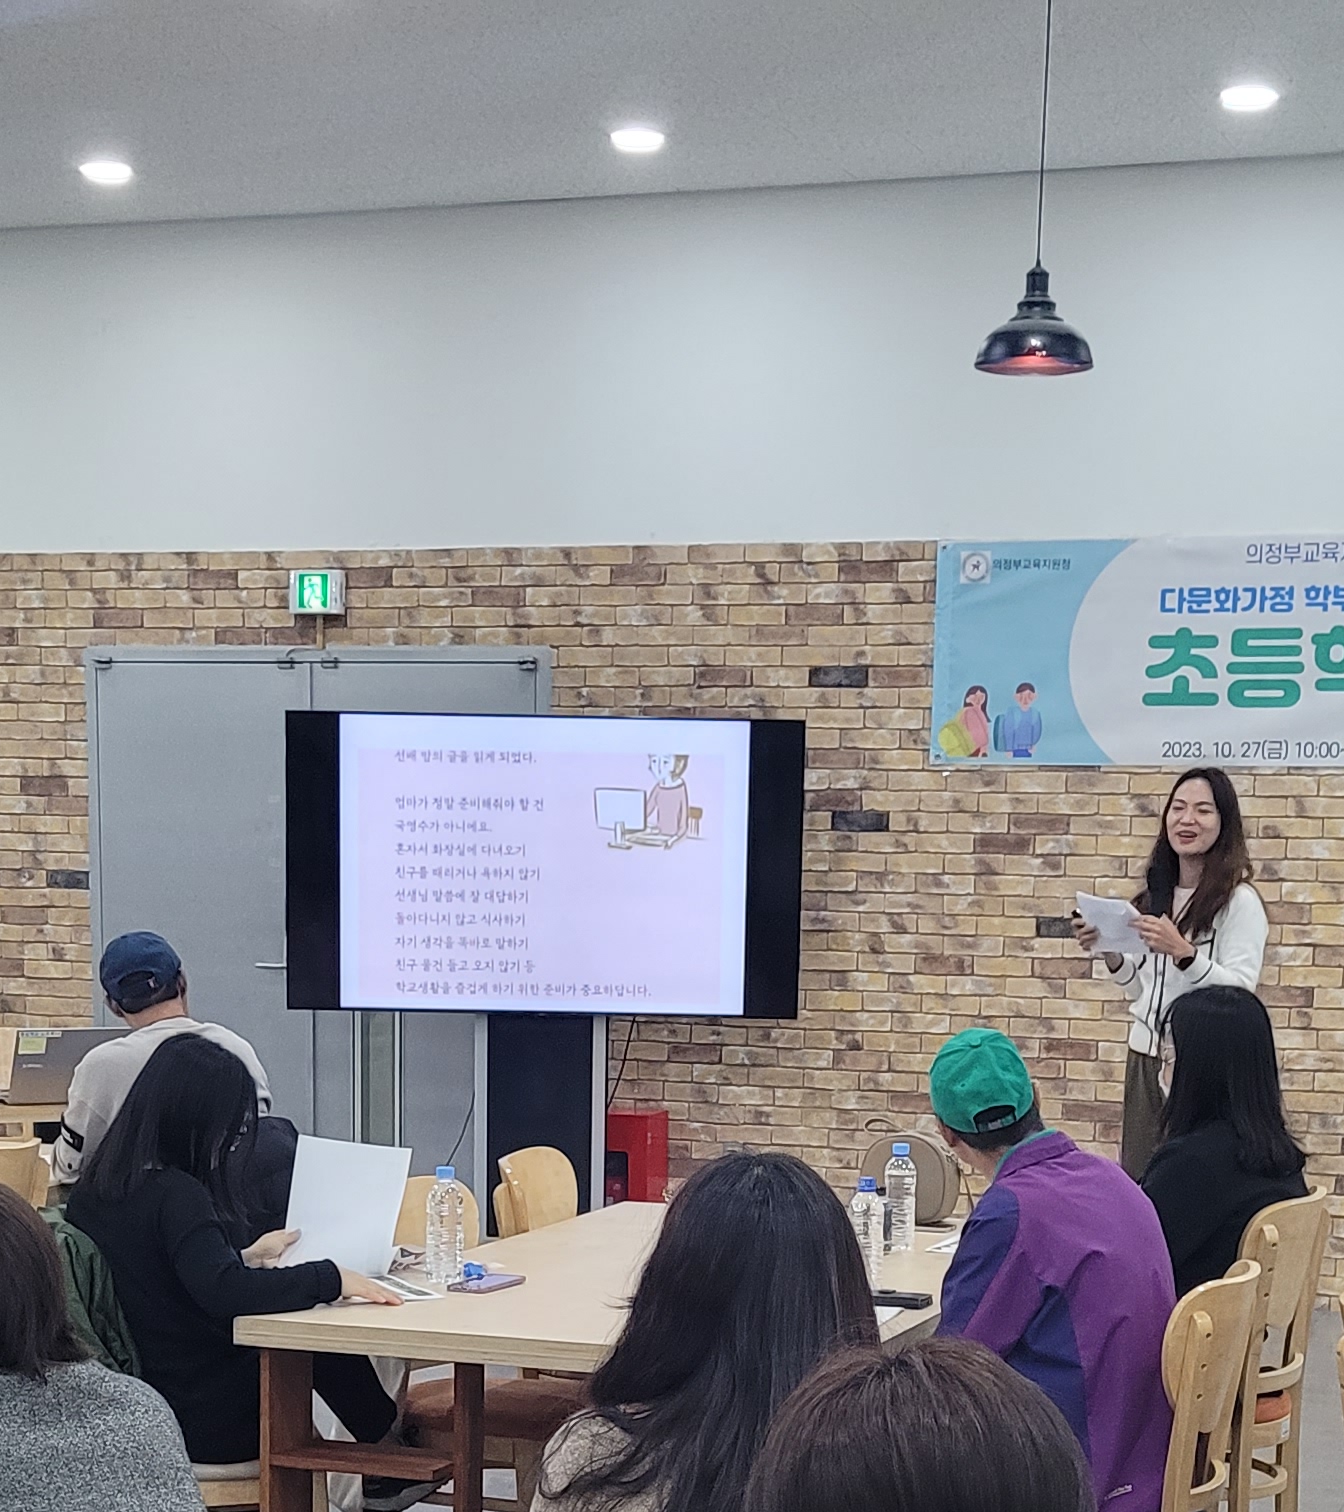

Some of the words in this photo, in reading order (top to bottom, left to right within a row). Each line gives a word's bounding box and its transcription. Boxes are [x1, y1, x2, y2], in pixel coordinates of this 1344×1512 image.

[1159, 584, 1295, 614] 다문화가정
[498, 751, 537, 764] 되었다.
[1160, 740, 1207, 759] 2023.
[1212, 740, 1236, 759] 10.
[1240, 739, 1290, 761] 27(금)
[395, 795, 428, 810] 엄마가
[533, 797, 544, 811] 건
[444, 819, 493, 833] 아니에요.
[394, 842, 428, 856] 혼자서
[431, 842, 477, 856] 화장실에
[481, 843, 526, 857] 다녀오기
[395, 865, 429, 880] 친구를
[432, 865, 477, 880] 때리거나
[518, 866, 541, 881] 않기
[394, 888, 428, 903] 선생님
[431, 888, 466, 903] 말씀에
[484, 889, 529, 904] 대답하기
[395, 911, 452, 926] 돌아다니지
[455, 911, 478, 926] 않고
[480, 912, 526, 927] 식사하기
[394, 935, 417, 949] 자기
[420, 935, 455, 950] 생각을
[495, 936, 529, 951] 말하기
[395, 958, 418, 972] 친구
[472, 958, 494, 972] 오지
[498, 958, 520, 973] 않기
[396, 980, 452, 995] 학교생활을
[492, 982, 514, 995] 하기
[517, 983, 539, 996] 위한
[543, 982, 576, 997] 준비가
[580, 983, 652, 997] 중요하답니다.
